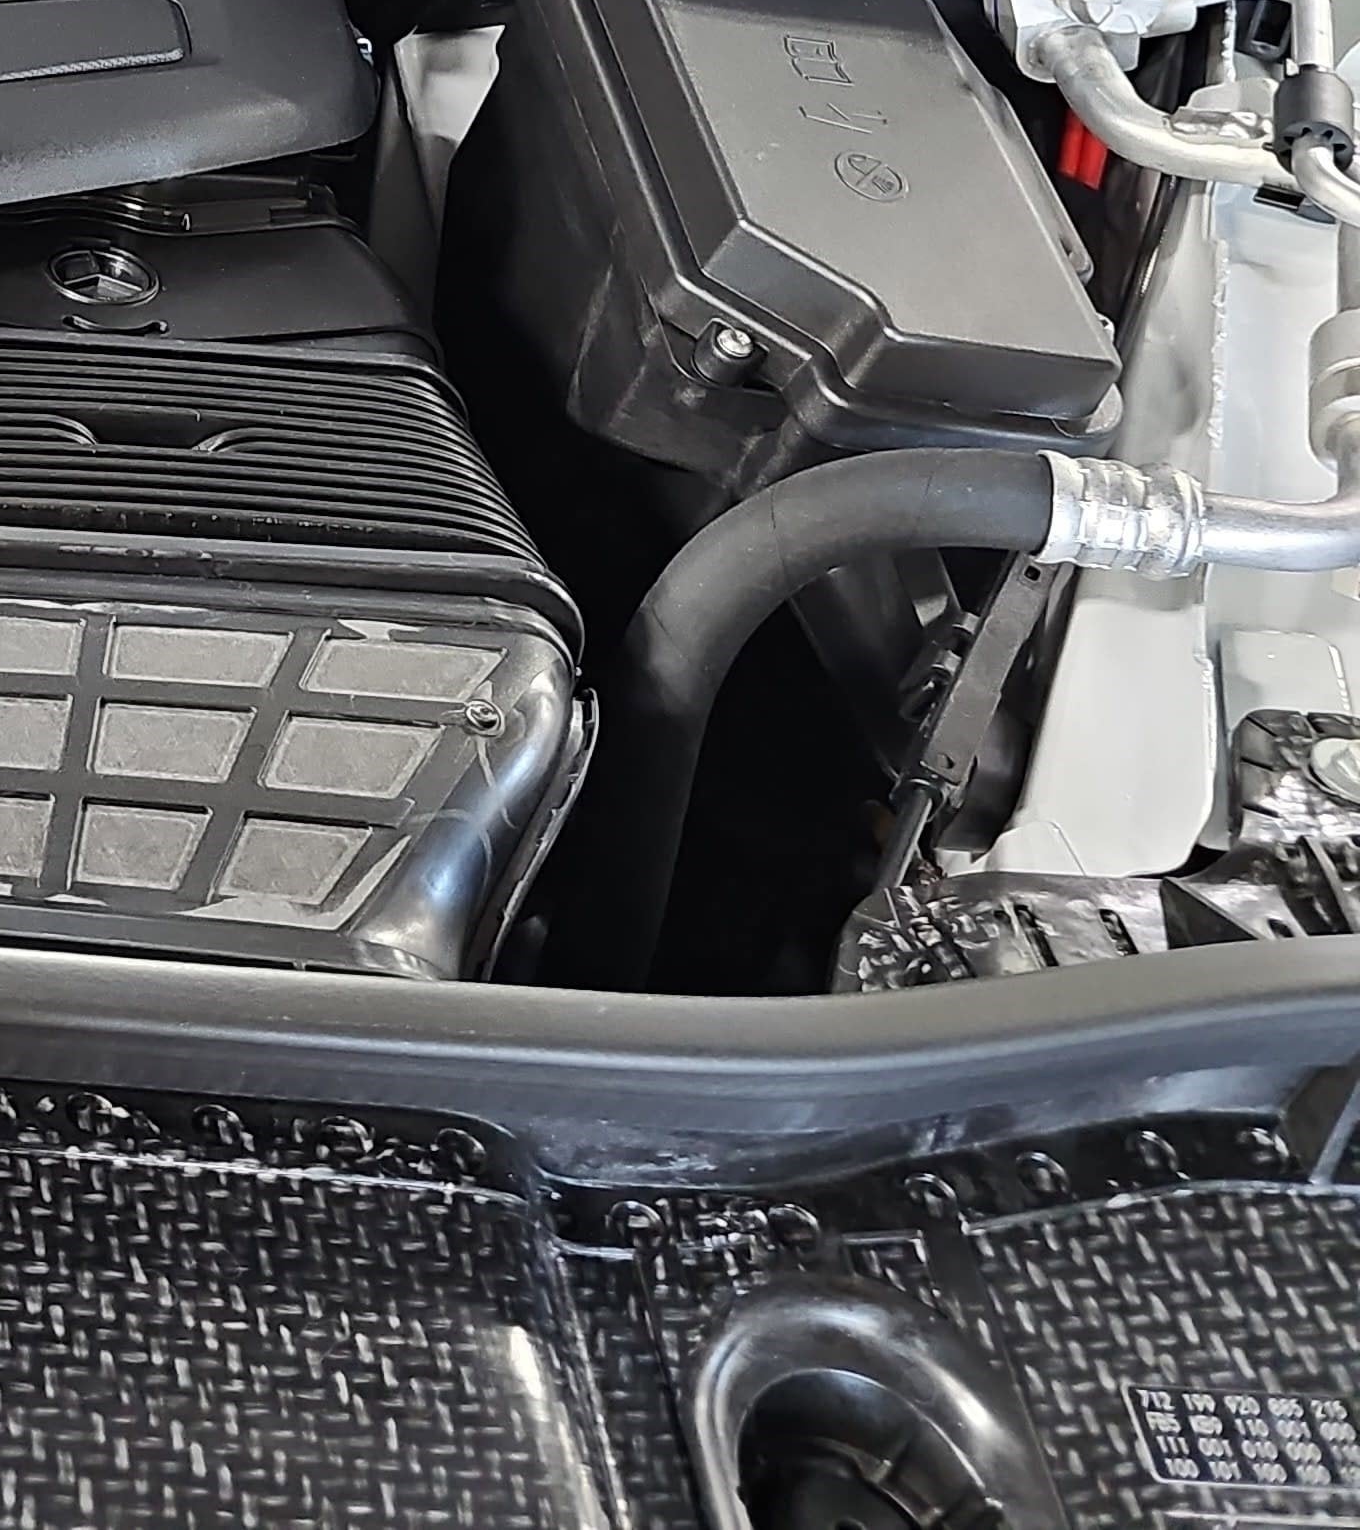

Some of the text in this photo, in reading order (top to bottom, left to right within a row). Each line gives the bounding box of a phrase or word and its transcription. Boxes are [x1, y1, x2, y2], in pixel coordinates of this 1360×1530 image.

[1136, 1389, 1175, 1411] 712
[1156, 1435, 1190, 1455] 111
[1164, 1457, 1200, 1479] 100
